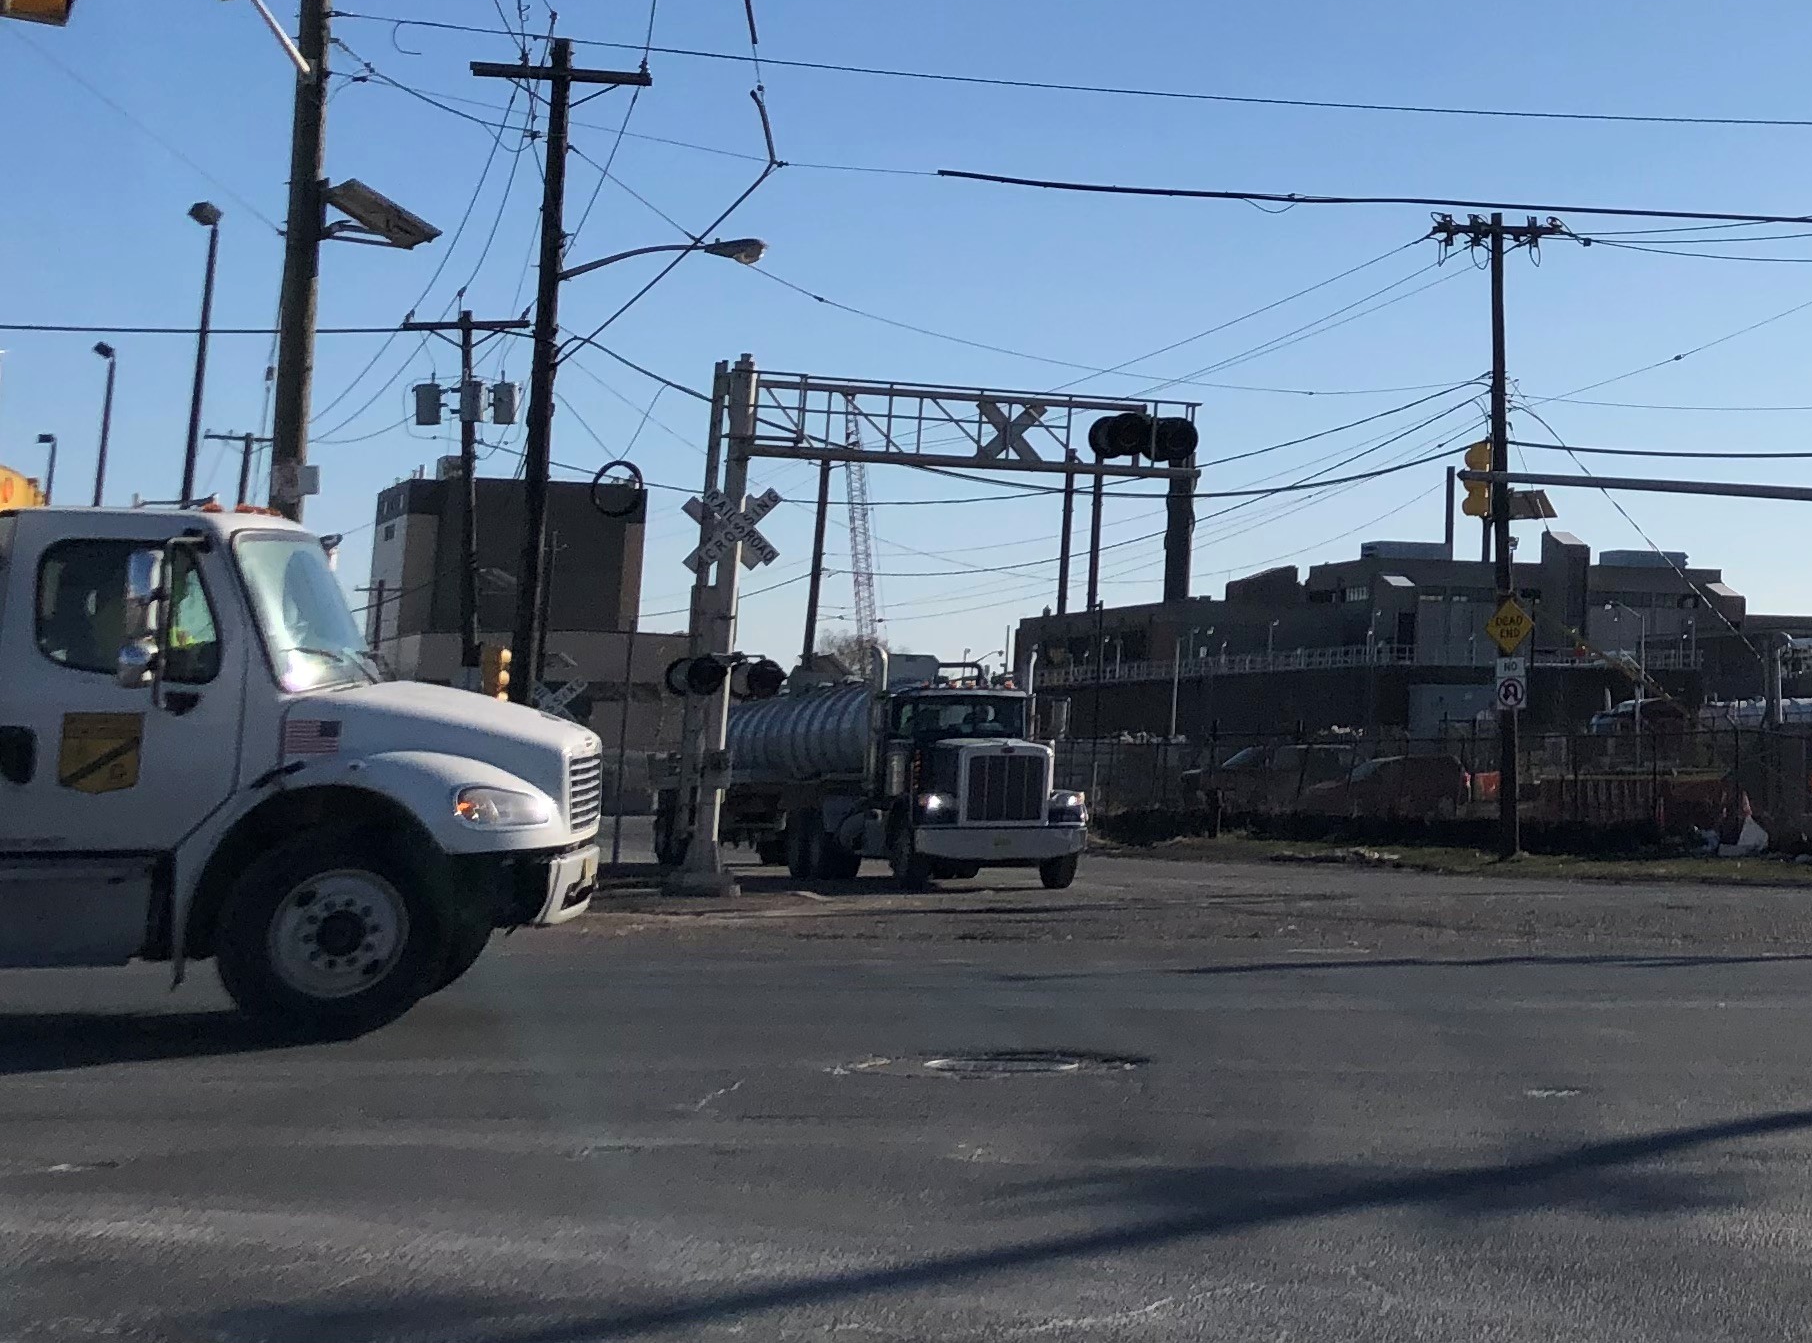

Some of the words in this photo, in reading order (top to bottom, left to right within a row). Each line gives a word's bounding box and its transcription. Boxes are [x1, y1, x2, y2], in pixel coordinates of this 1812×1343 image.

[705, 492, 779, 560] CROSSING
[1495, 616, 1523, 626] DEAD
[1500, 629, 1520, 639] END
[1504, 661, 1518, 672] NO
